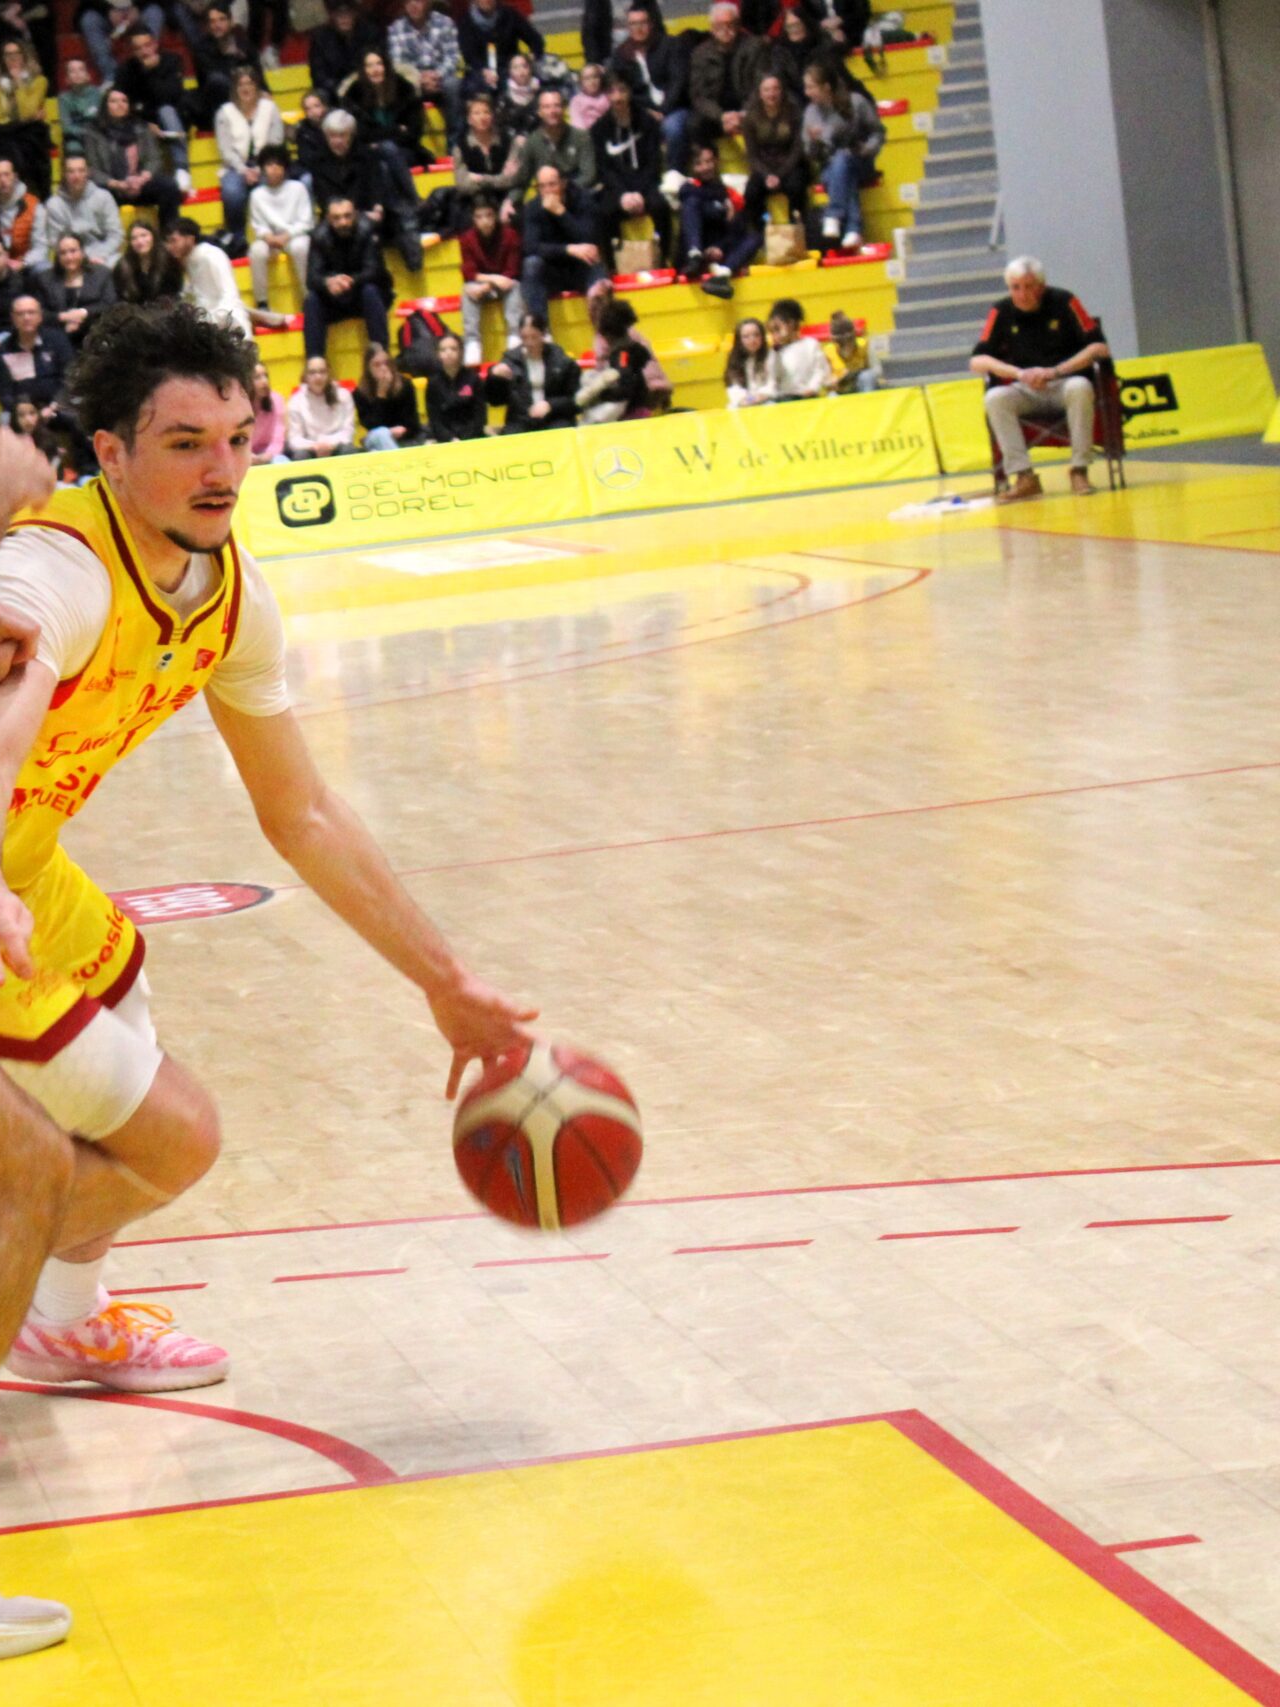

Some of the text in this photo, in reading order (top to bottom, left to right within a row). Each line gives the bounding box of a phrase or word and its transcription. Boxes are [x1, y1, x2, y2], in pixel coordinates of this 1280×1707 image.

[1121, 384, 1169, 409] OL
[779, 430, 926, 464] Willermin
[347, 460, 555, 500] DELMONICO
[350, 495, 474, 521] DOREL
